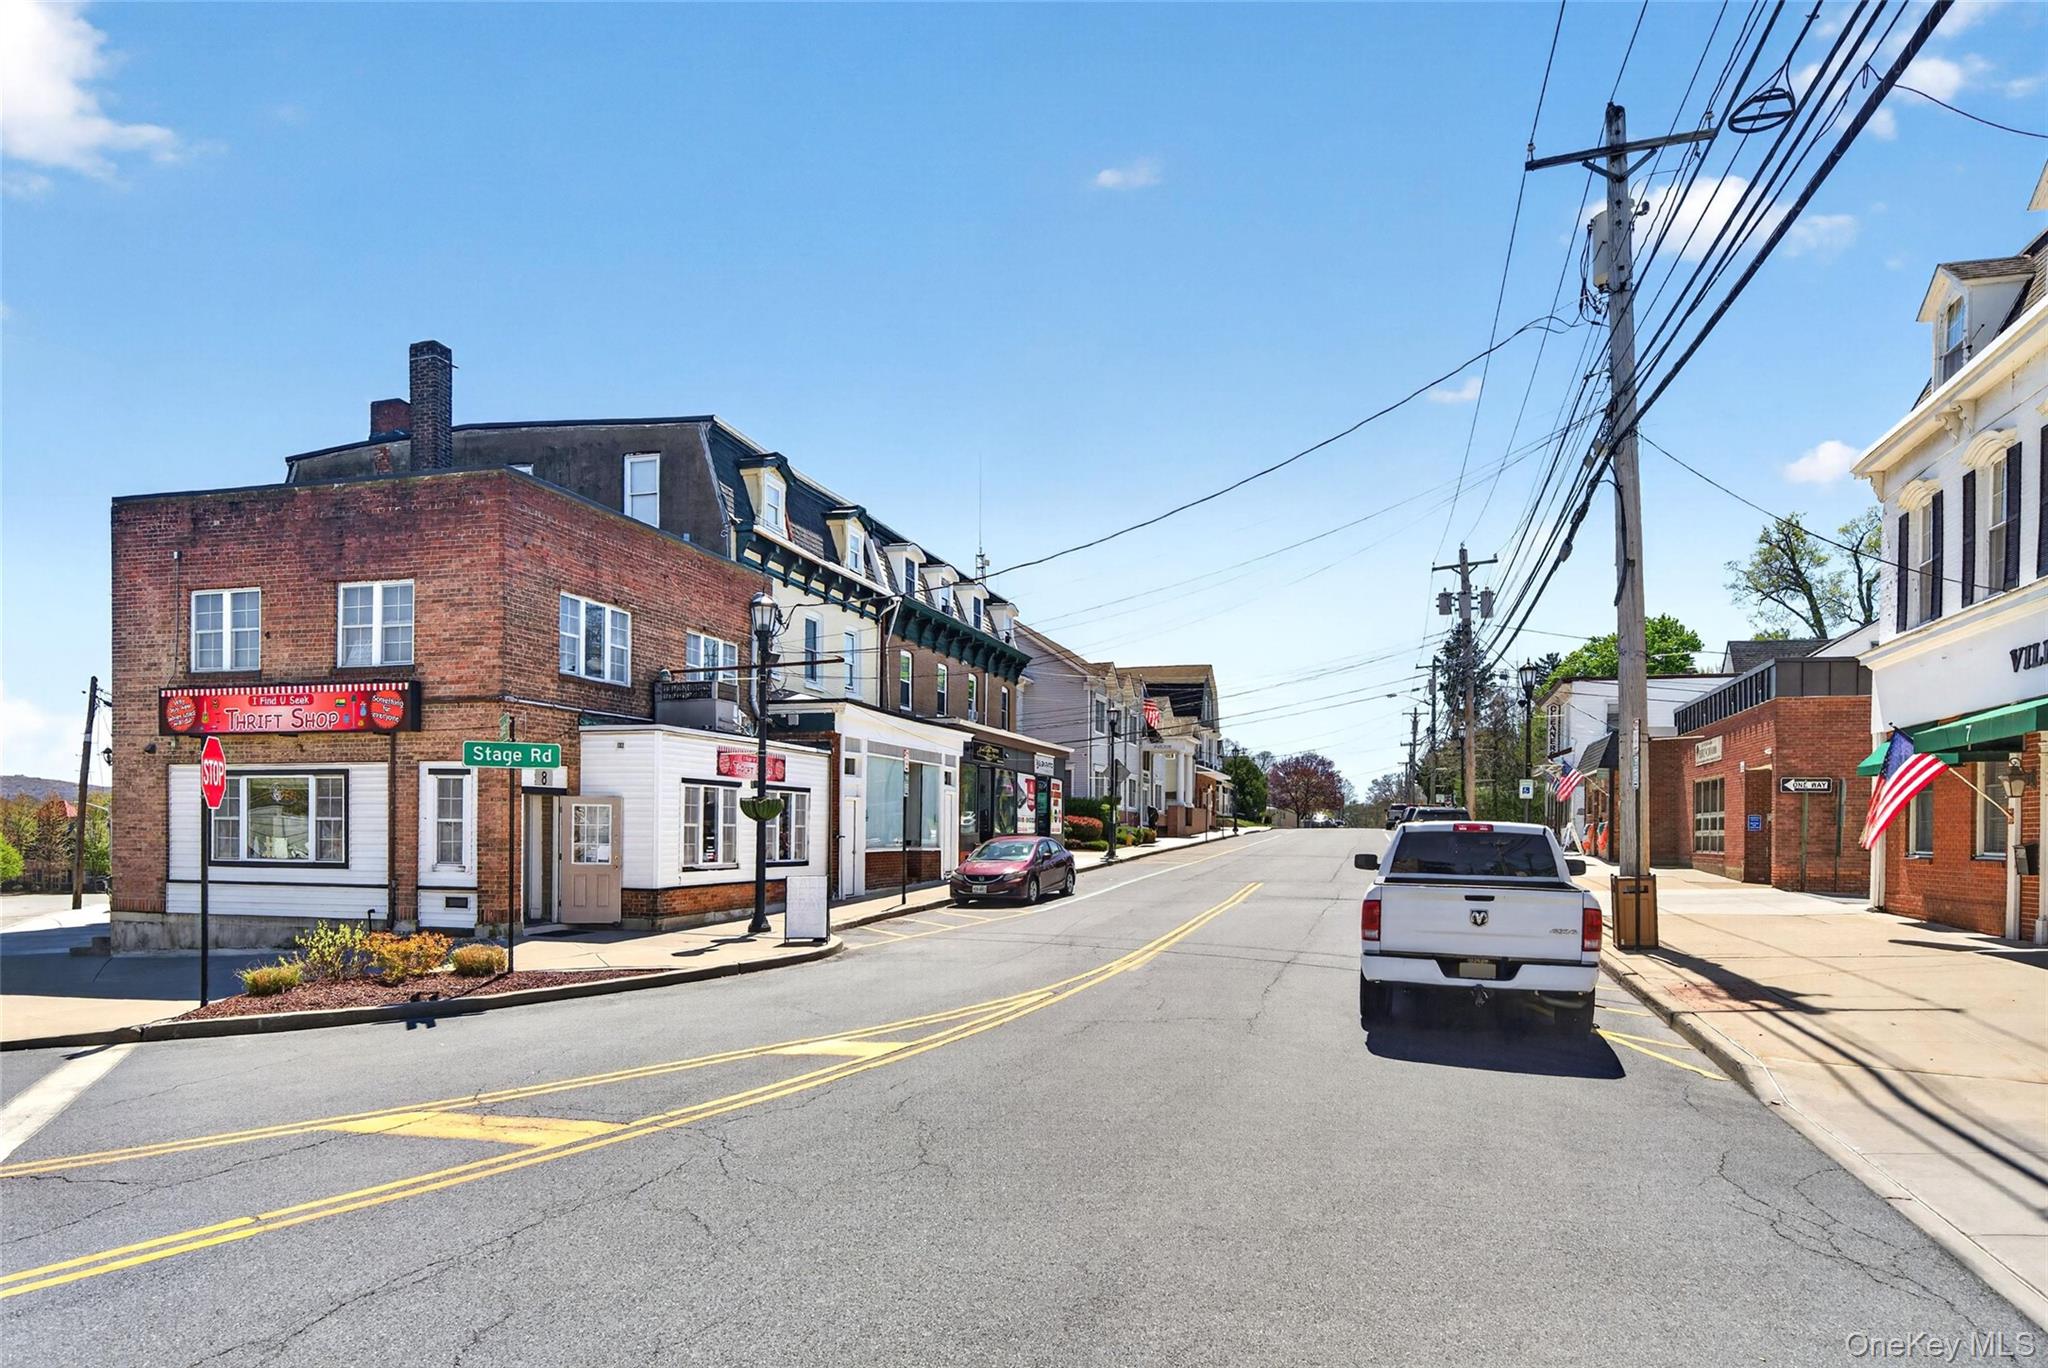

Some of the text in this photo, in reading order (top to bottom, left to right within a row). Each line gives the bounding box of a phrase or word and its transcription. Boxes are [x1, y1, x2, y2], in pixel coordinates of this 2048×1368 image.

[252, 695, 309, 705] I Find U Seek
[371, 695, 404, 708] Something
[224, 707, 339, 731] THRIFT SHOP
[1965, 725, 1972, 742] 7
[473, 746, 552, 766] Stage Rd
[203, 759, 225, 786] STOP
[541, 771, 548, 786] 8
